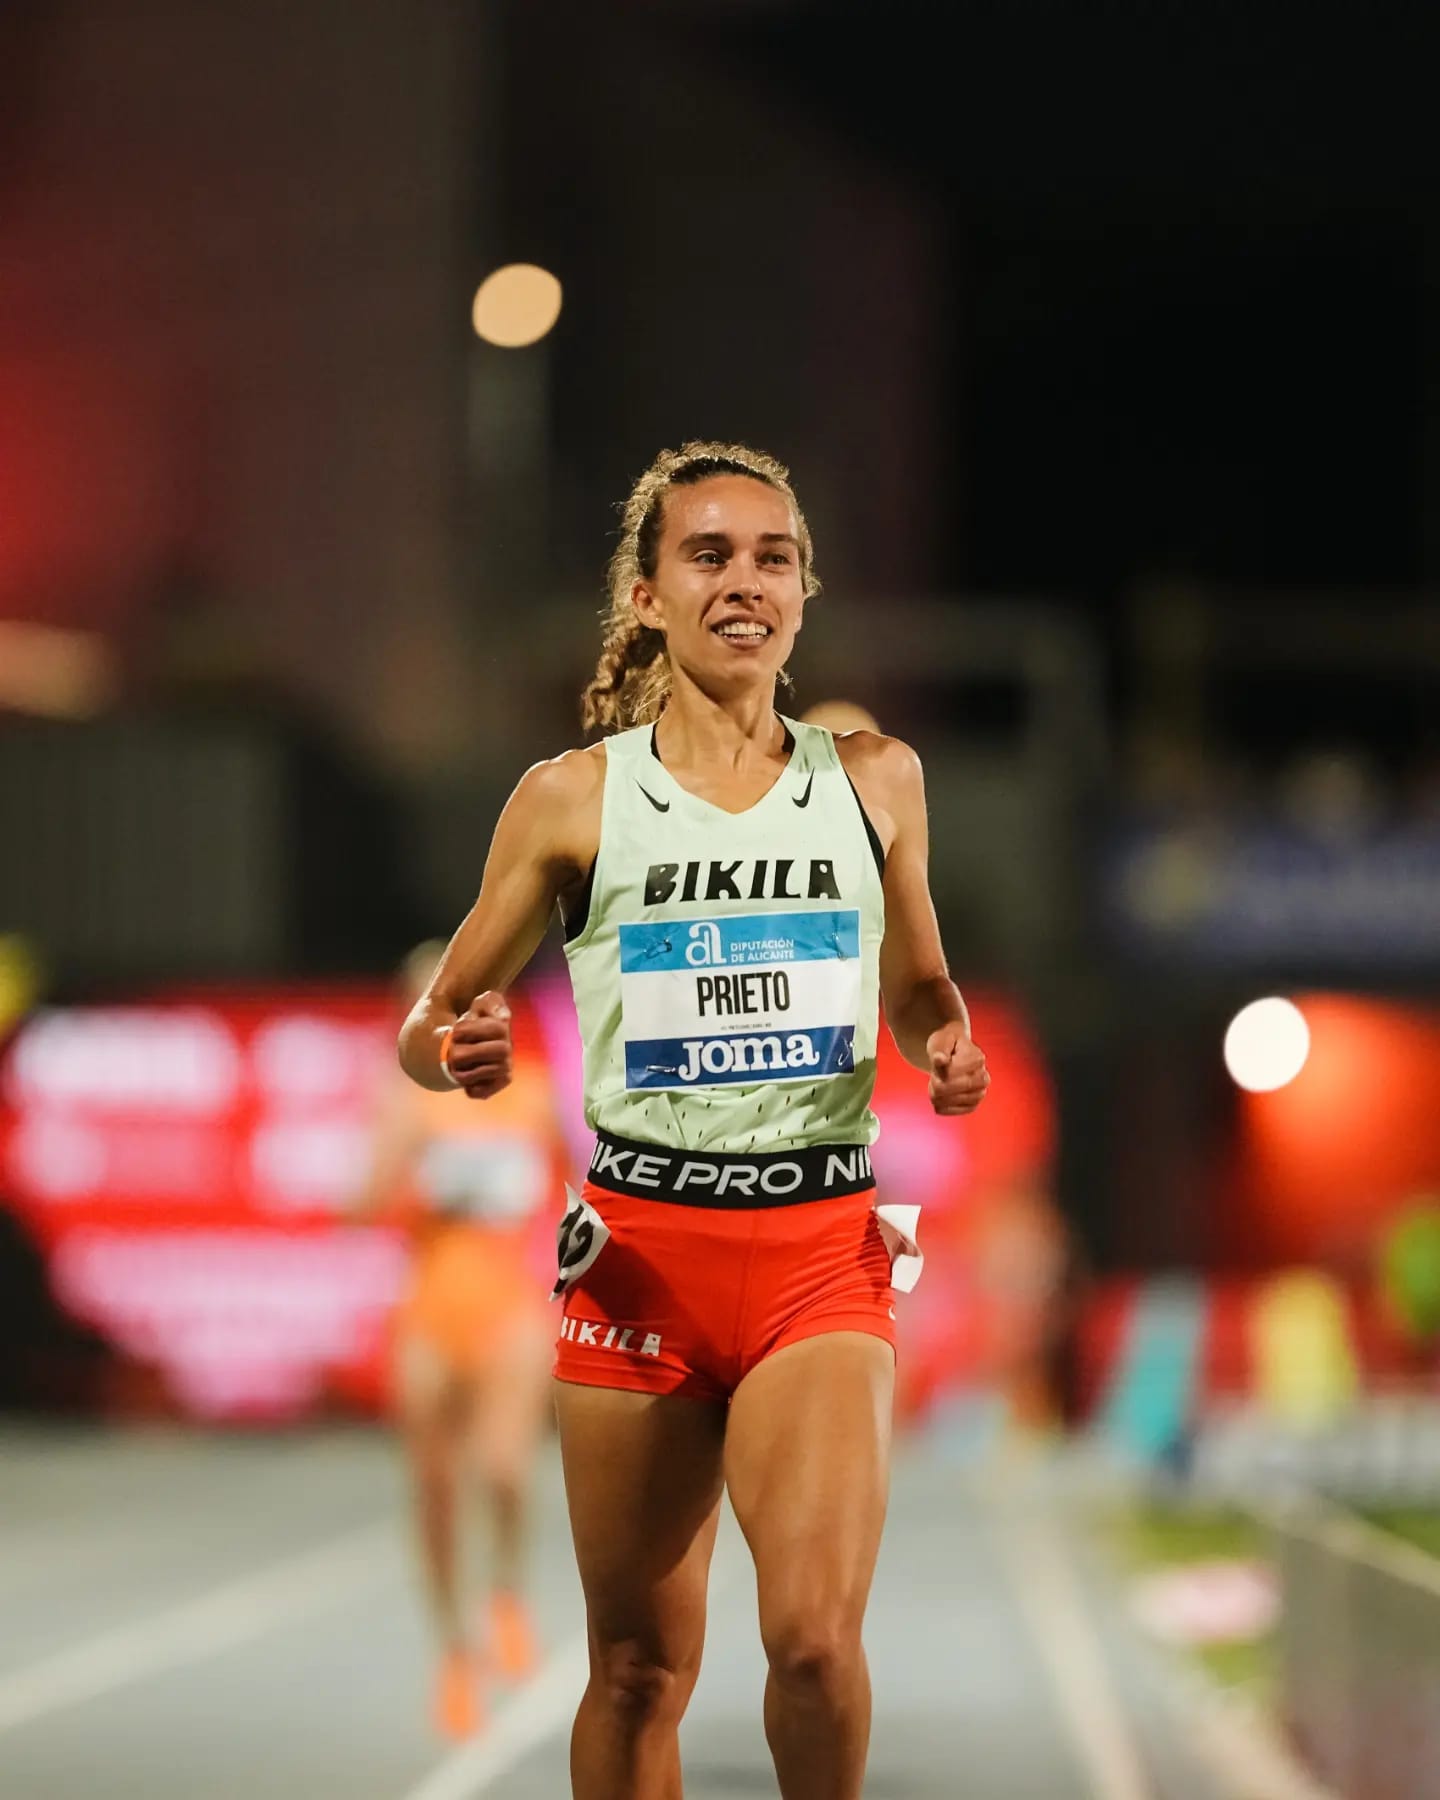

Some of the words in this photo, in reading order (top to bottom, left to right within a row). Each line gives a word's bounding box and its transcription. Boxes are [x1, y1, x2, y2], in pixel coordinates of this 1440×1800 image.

[644, 859, 841, 906] BIKILA
[730, 937, 794, 952] DIPUTACIÓN
[731, 953, 745, 963] DE
[747, 949, 795, 961] ALICANTE
[697, 970, 790, 1016] PRIETO
[592, 1140, 672, 1187] IKE
[672, 1160, 803, 1196] PRO
